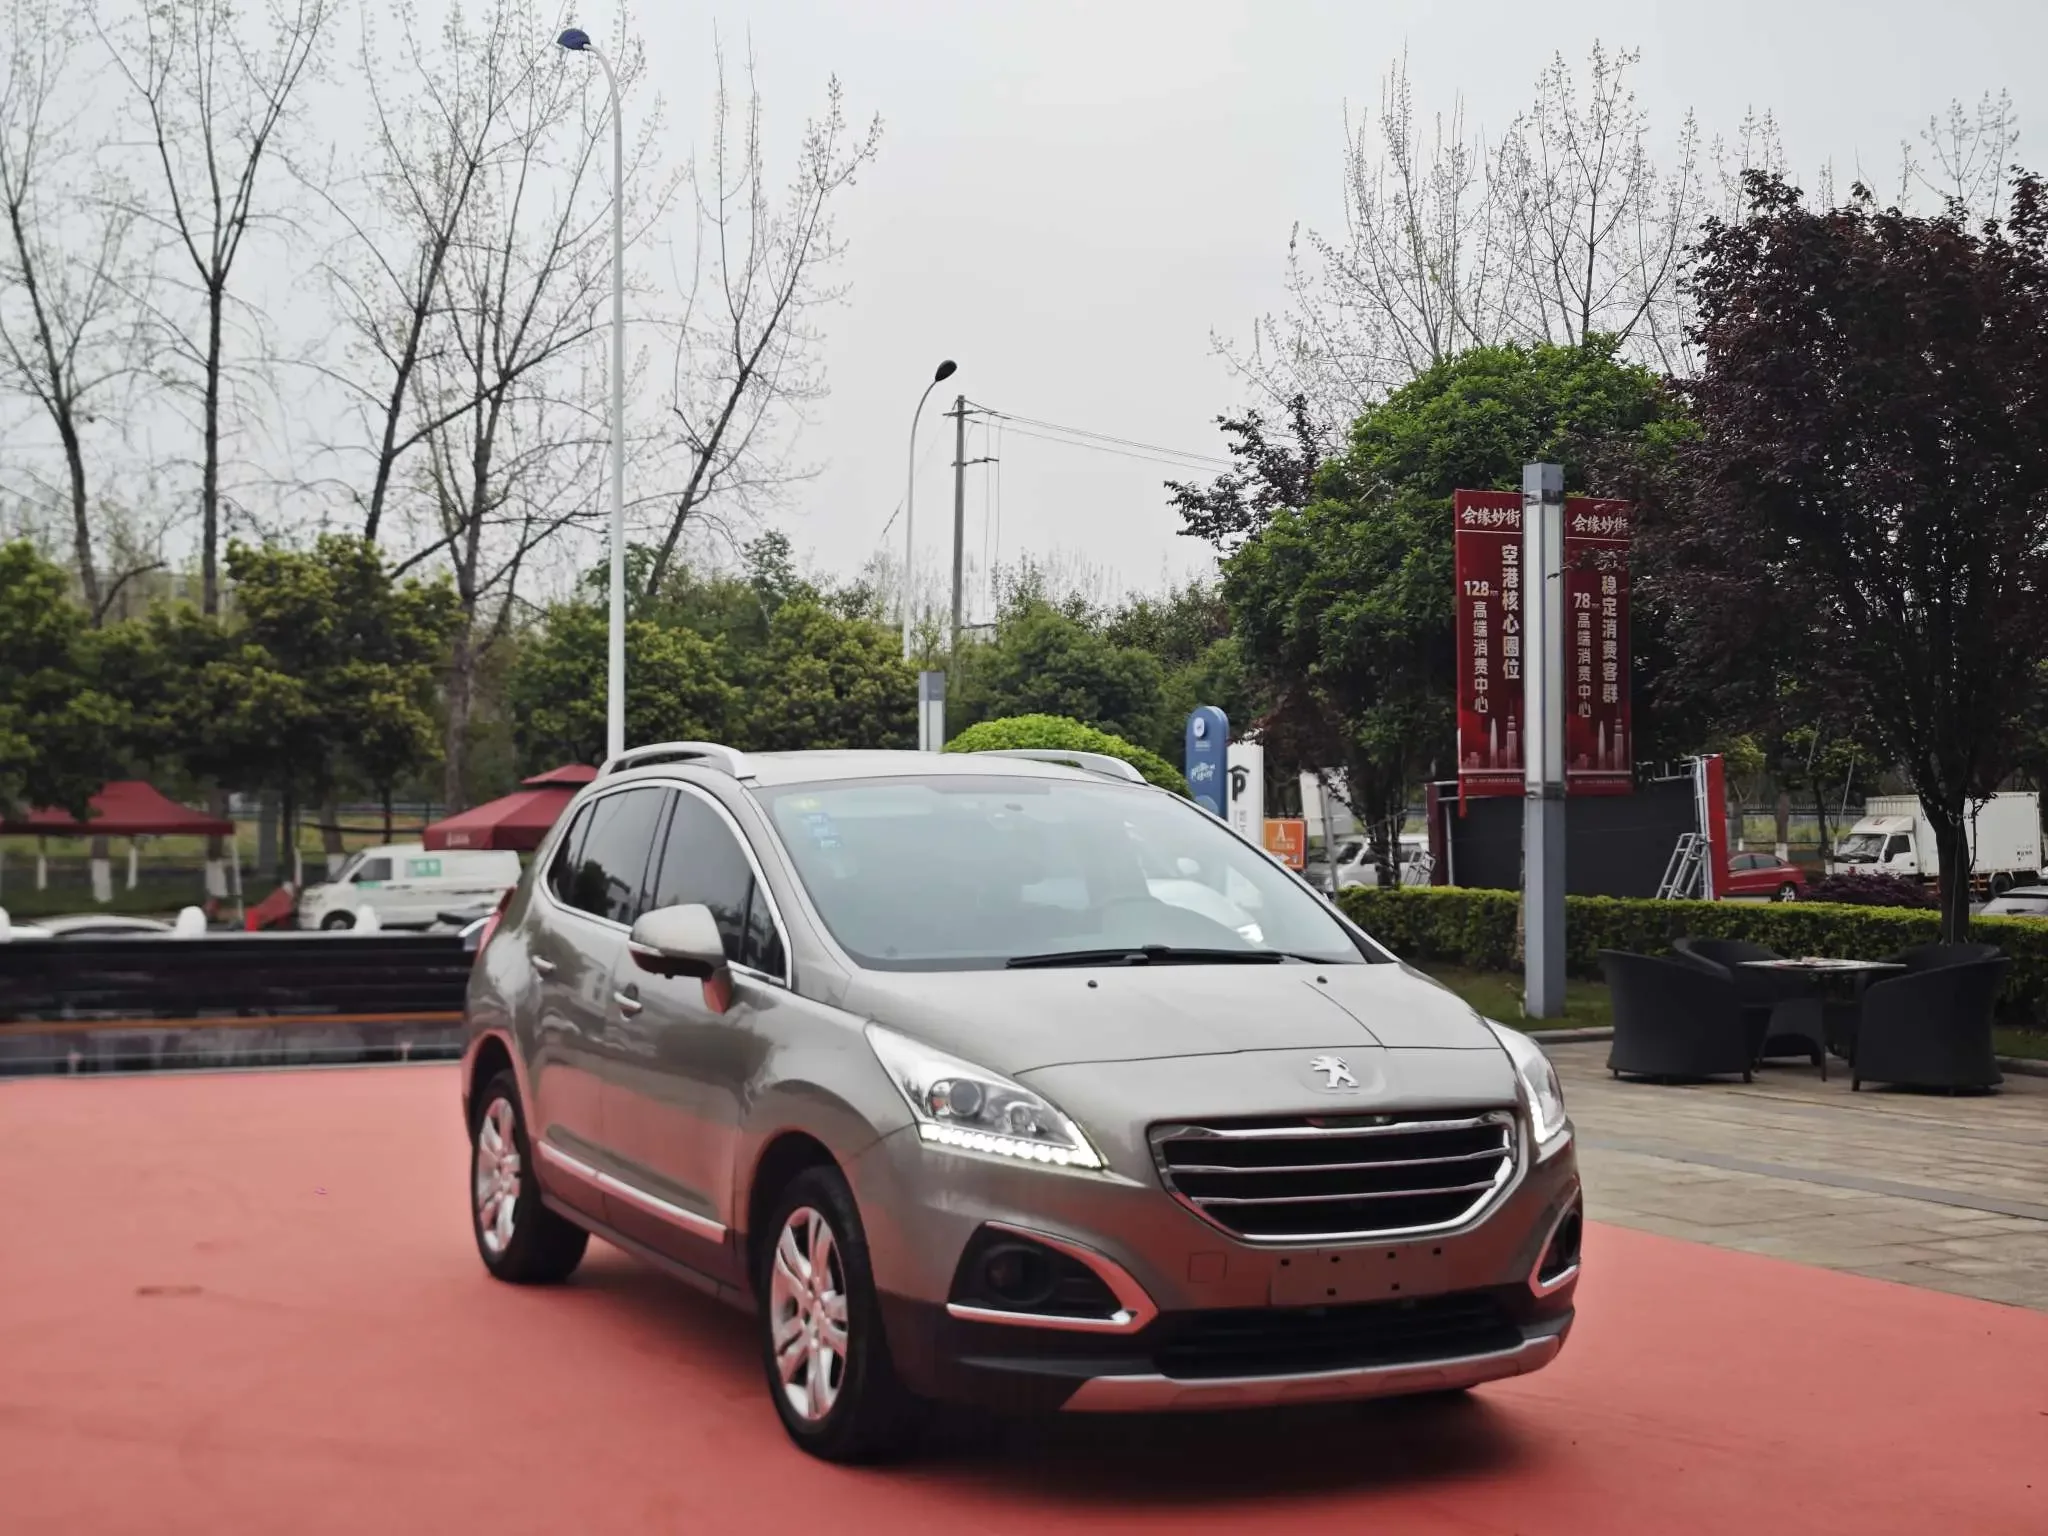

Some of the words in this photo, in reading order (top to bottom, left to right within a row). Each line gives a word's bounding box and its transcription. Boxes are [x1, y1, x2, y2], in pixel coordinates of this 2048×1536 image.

[1460, 505, 1521, 529] 会缘妙街
[1473, 601, 1489, 713] 高端消费中心
[1577, 612, 1592, 718] 高端消费中心
